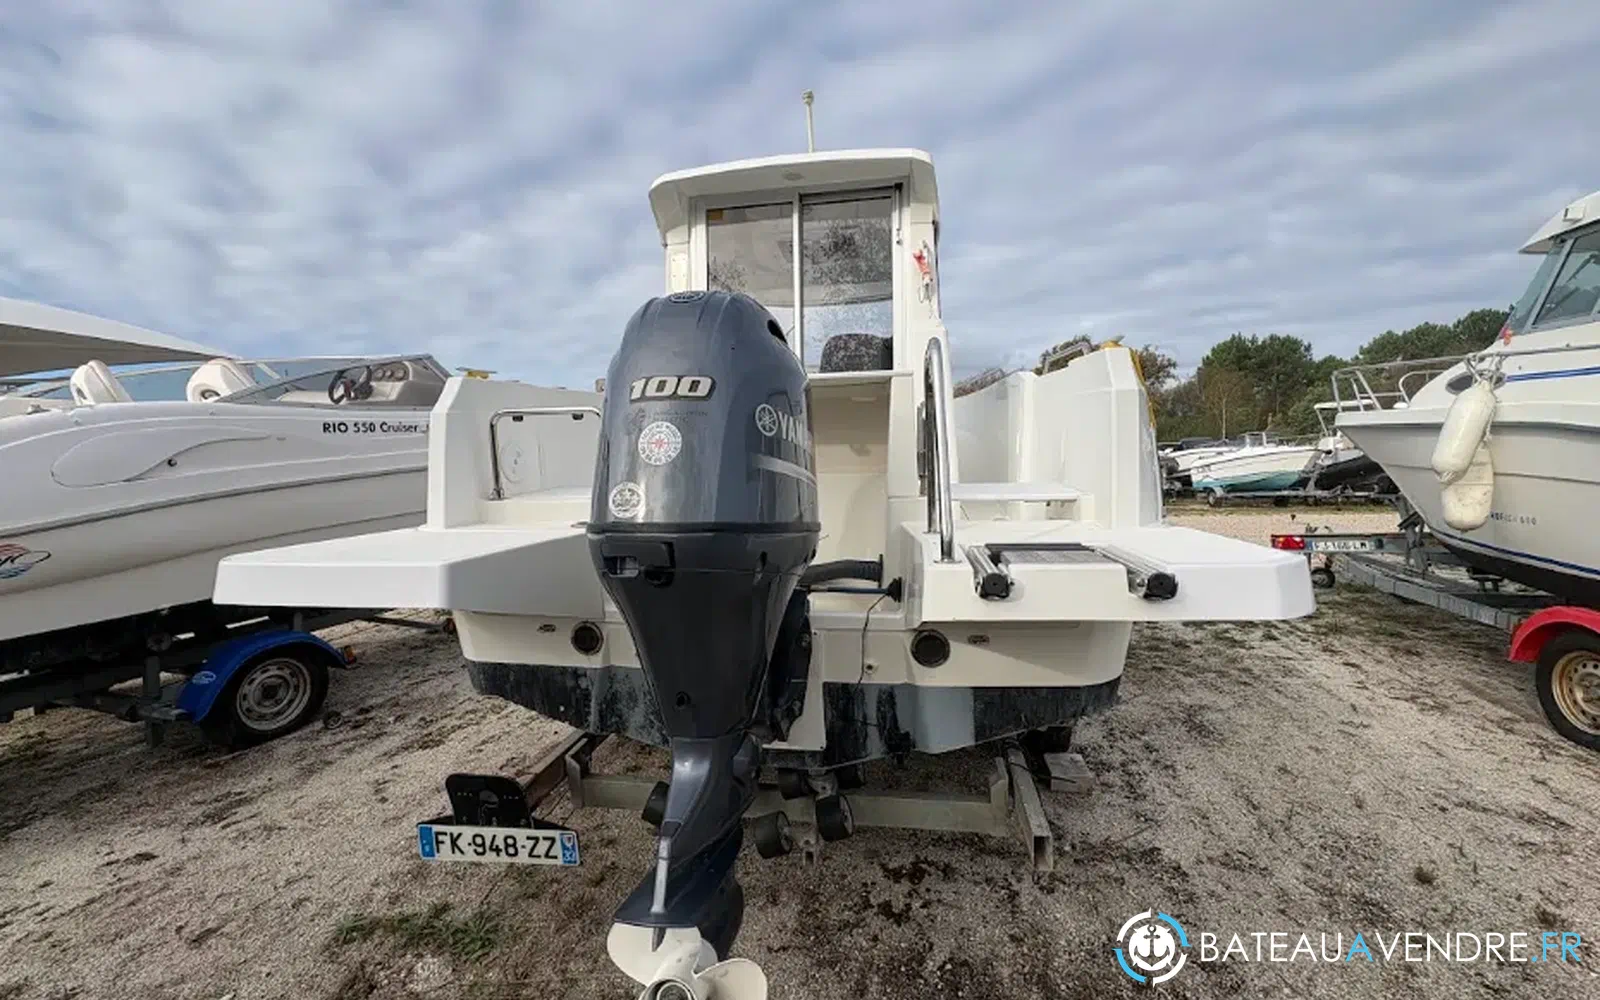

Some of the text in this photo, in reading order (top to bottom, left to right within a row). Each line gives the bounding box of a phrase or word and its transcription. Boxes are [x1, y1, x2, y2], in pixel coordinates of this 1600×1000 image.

[629, 375, 716, 401] 100
[322, 421, 418, 434] RIO 550 Cruiser
[434, 831, 559, 860] FK-948-ZZ
